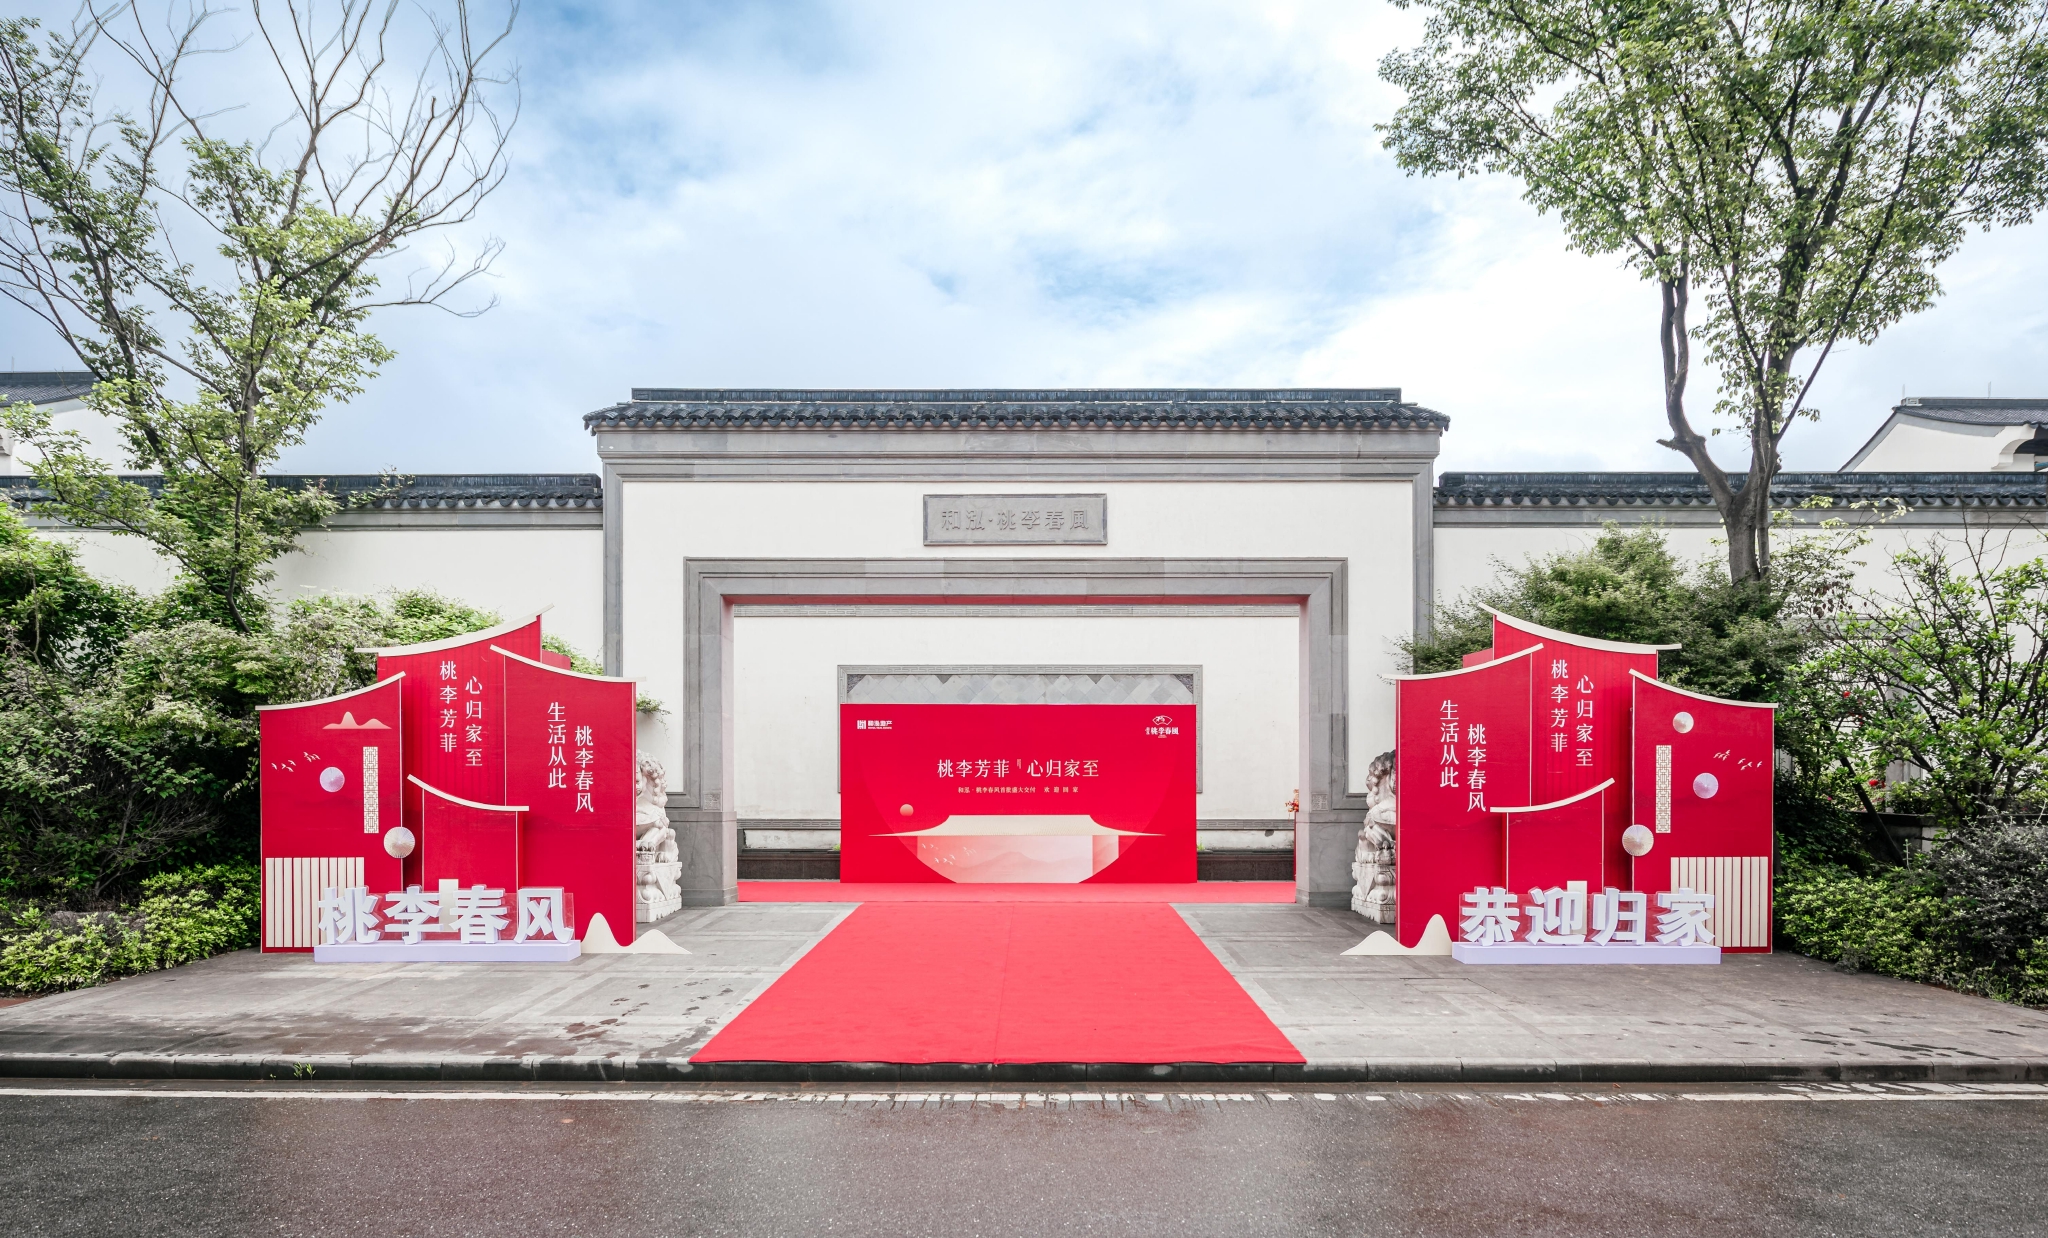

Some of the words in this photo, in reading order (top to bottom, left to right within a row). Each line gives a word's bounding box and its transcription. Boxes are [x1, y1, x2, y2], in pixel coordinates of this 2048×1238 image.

[440, 660, 457, 753] 桃李芳菲
[465, 676, 483, 766] 心归家至
[547, 702, 567, 789] 生活从此
[1439, 700, 1459, 788] 生活从此
[1550, 659, 1569, 753] 桃李芳菲
[1576, 674, 1595, 767] 心归家至
[574, 725, 594, 813] 桃李春风
[936, 759, 1010, 778] 桃李芳菲
[1026, 759, 1099, 778] 心归家至
[1467, 723, 1487, 812] 桃李春风
[318, 885, 574, 945] 桃李春风
[1460, 887, 1716, 947] 恭迎归家
